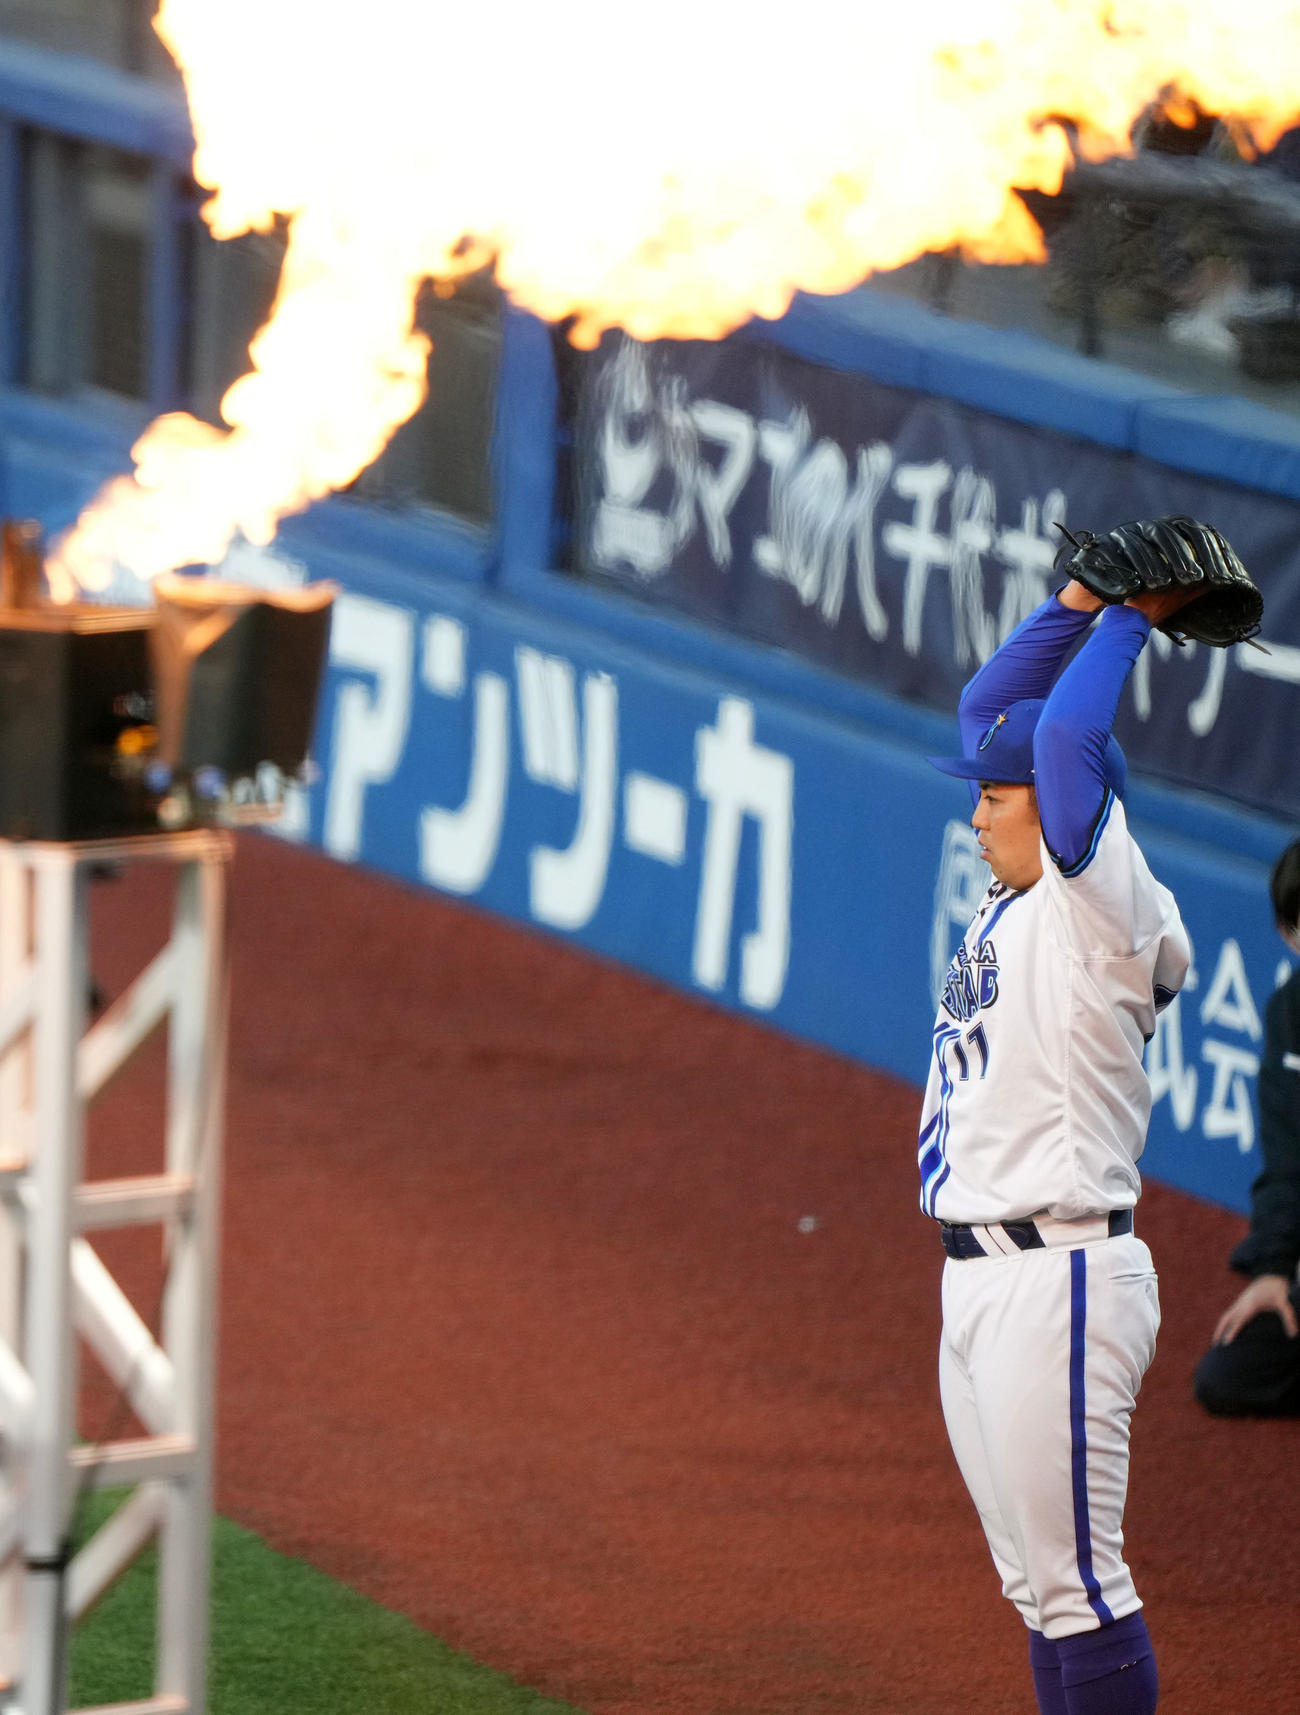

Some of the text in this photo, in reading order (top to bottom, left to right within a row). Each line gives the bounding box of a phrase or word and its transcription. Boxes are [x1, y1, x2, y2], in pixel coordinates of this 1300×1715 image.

[214, 545, 796, 1010] アンツーカ
